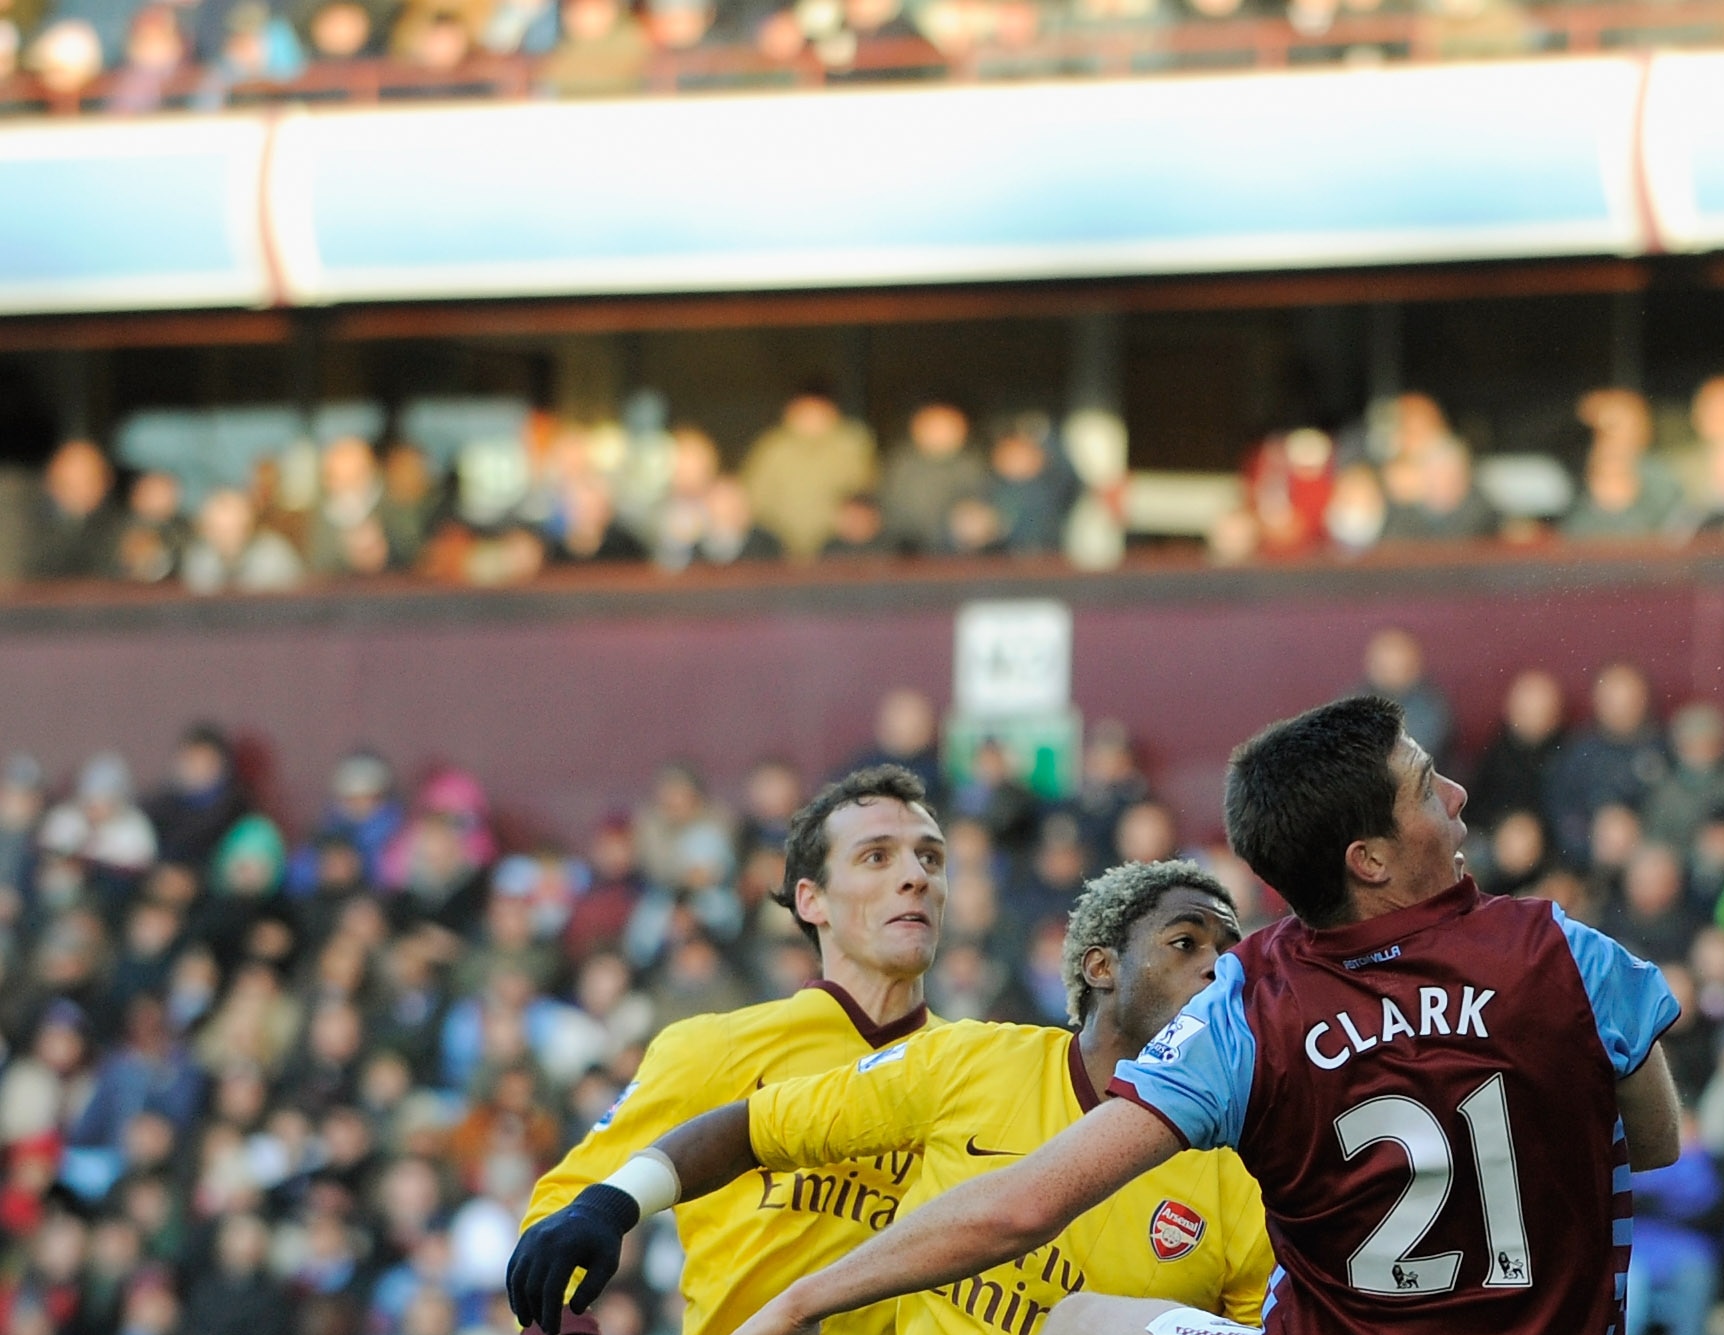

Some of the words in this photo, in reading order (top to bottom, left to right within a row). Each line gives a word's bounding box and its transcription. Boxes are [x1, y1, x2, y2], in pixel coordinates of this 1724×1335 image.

[1305, 986, 1496, 1070] CLARK
[1161, 1206, 1199, 1233] Arsenal
[1333, 1071, 1533, 1296] 21
